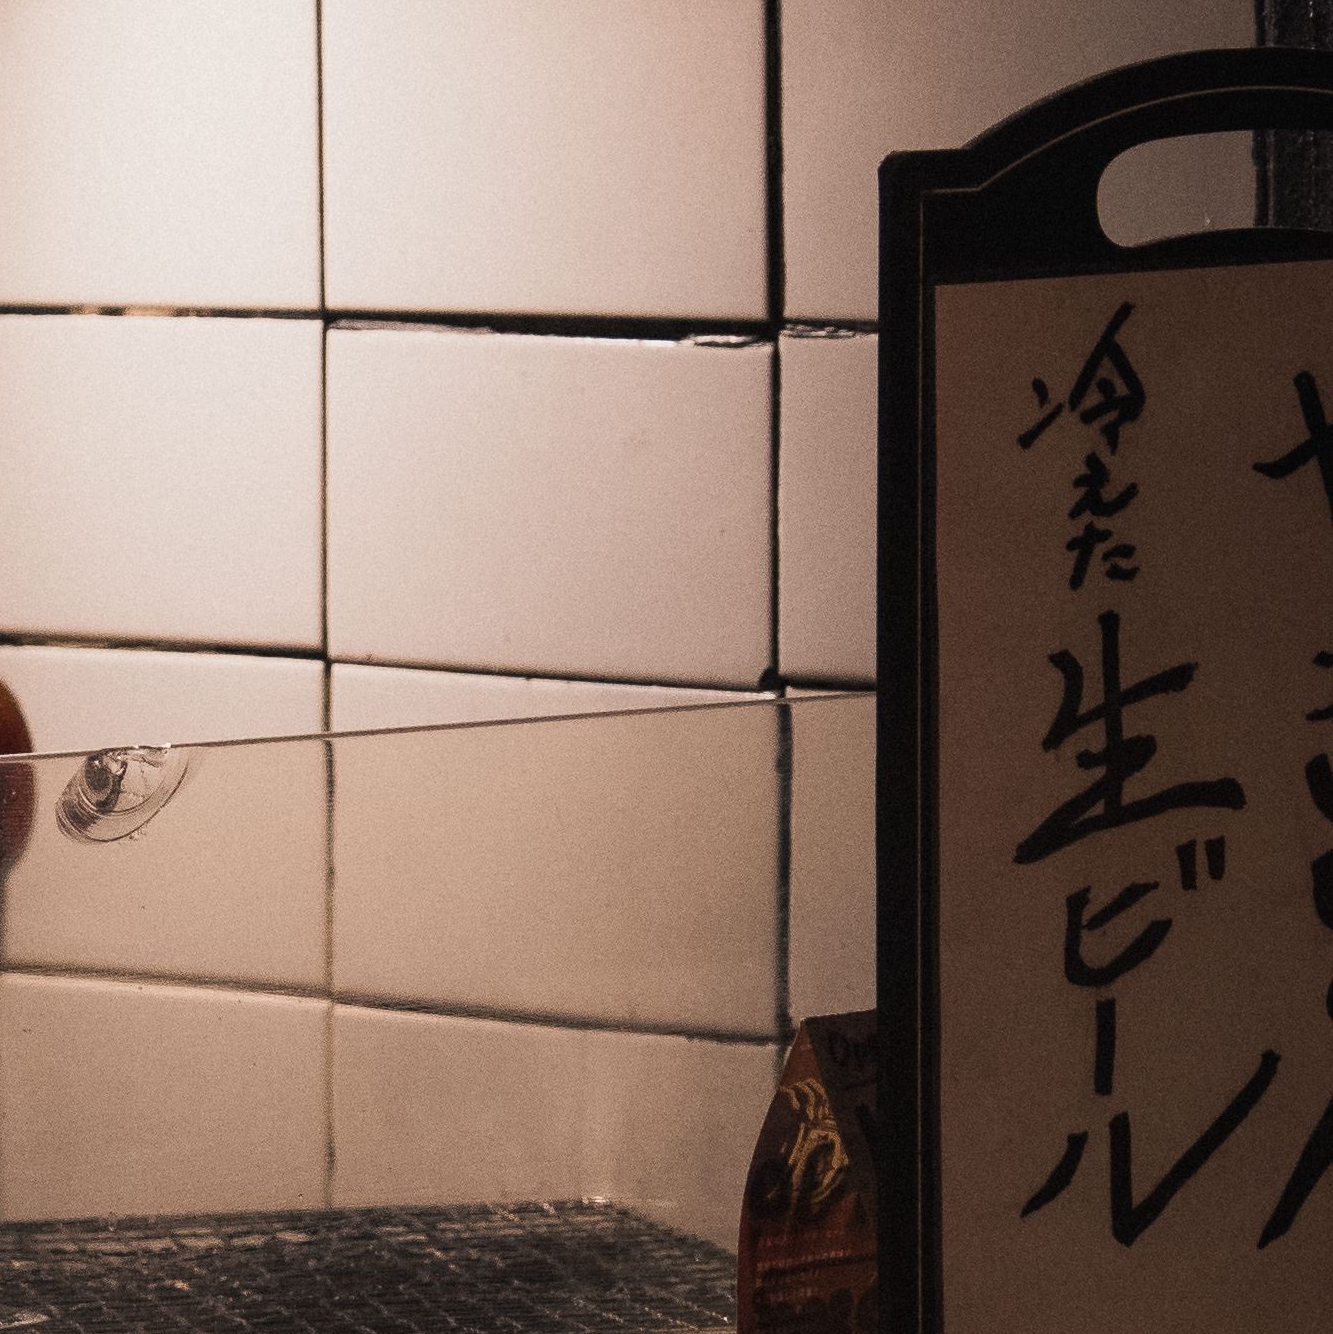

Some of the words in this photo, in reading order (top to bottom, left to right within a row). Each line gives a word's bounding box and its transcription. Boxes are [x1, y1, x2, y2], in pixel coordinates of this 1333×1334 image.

[1011, 300, 1281, 1249] 冷えた生ビール
